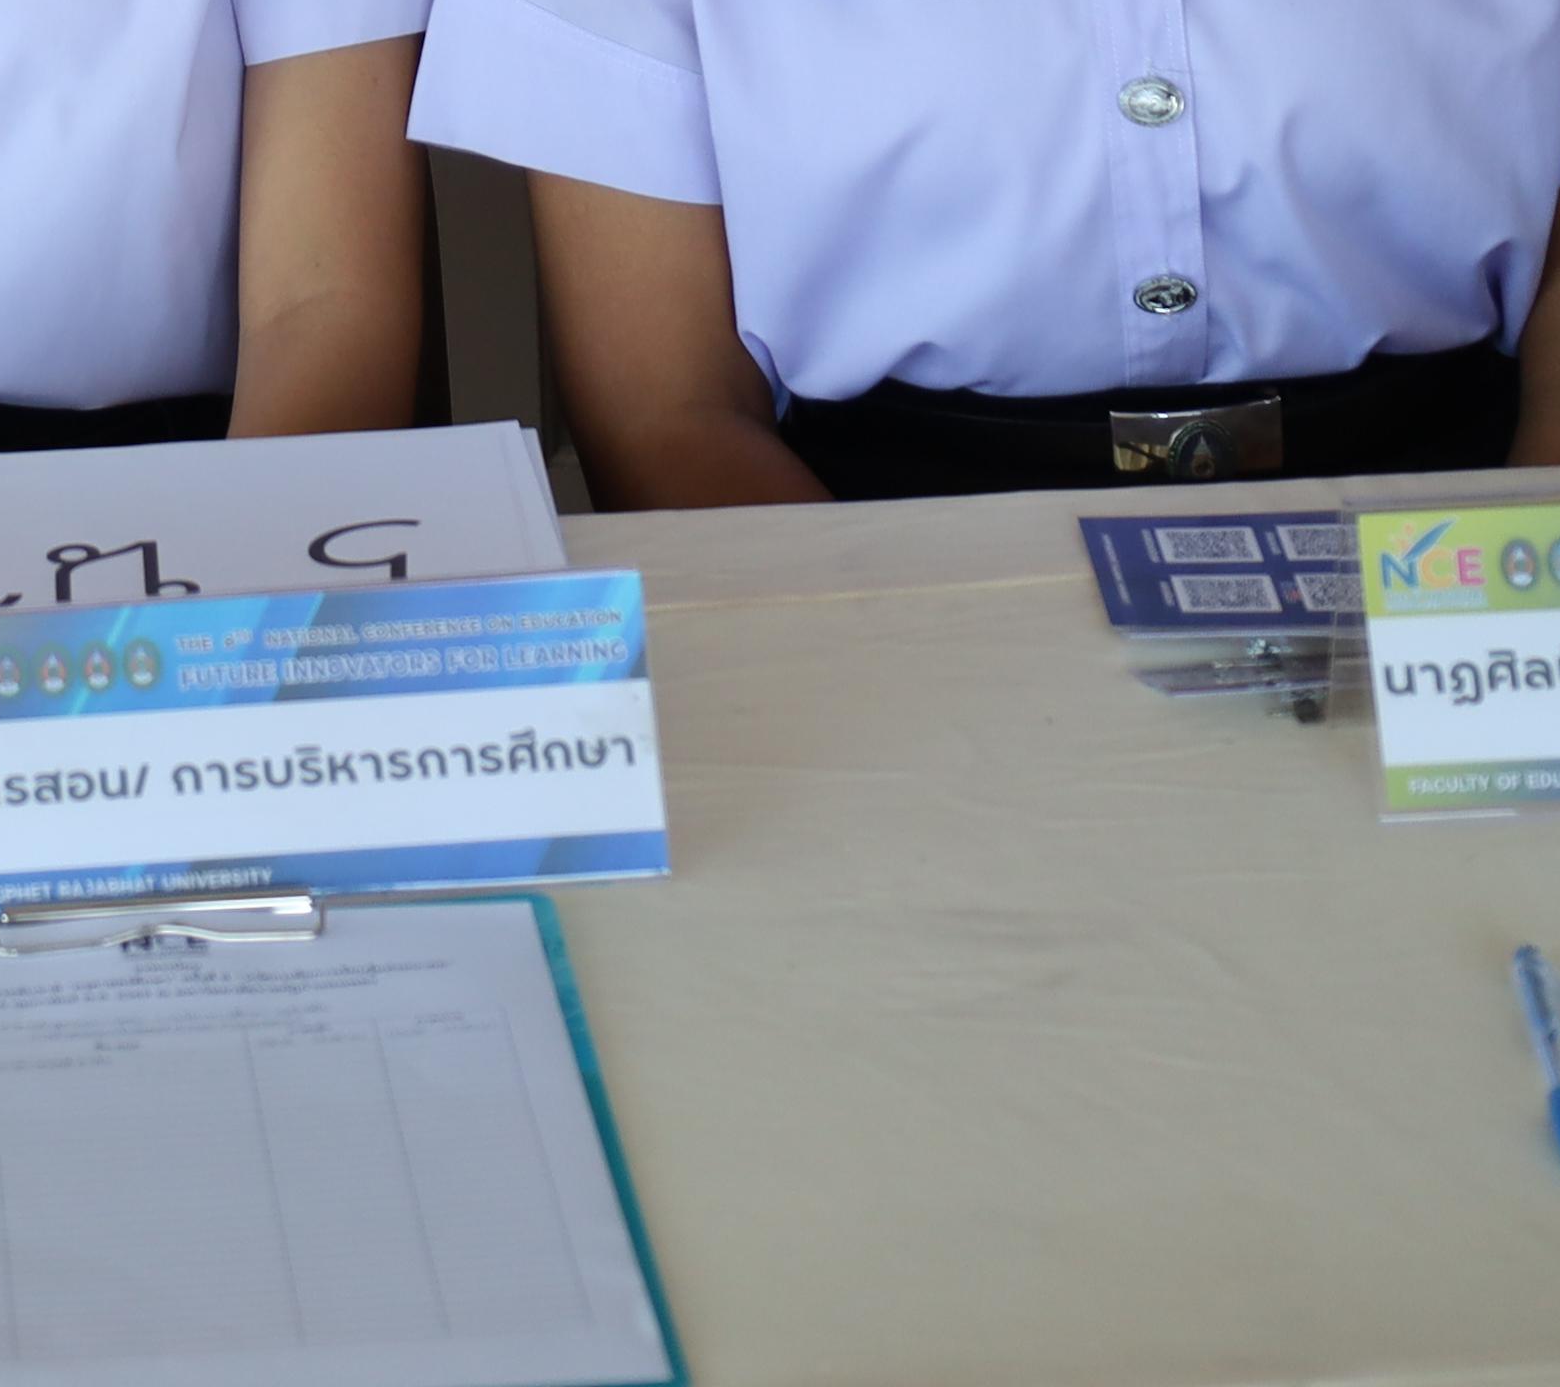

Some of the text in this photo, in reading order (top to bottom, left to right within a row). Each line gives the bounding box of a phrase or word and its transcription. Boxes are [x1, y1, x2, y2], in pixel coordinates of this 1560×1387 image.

[1380, 547, 1488, 590] NCE
[505, 638, 627, 669] LEARNING
[172, 727, 635, 797] การบริหารการศึกษา
[1408, 773, 1490, 796] FACULTY
[1495, 771, 1520, 790] OF
[57, 878, 156, 900] RAJABHAT
[160, 867, 272, 892] UNIVERSITY
